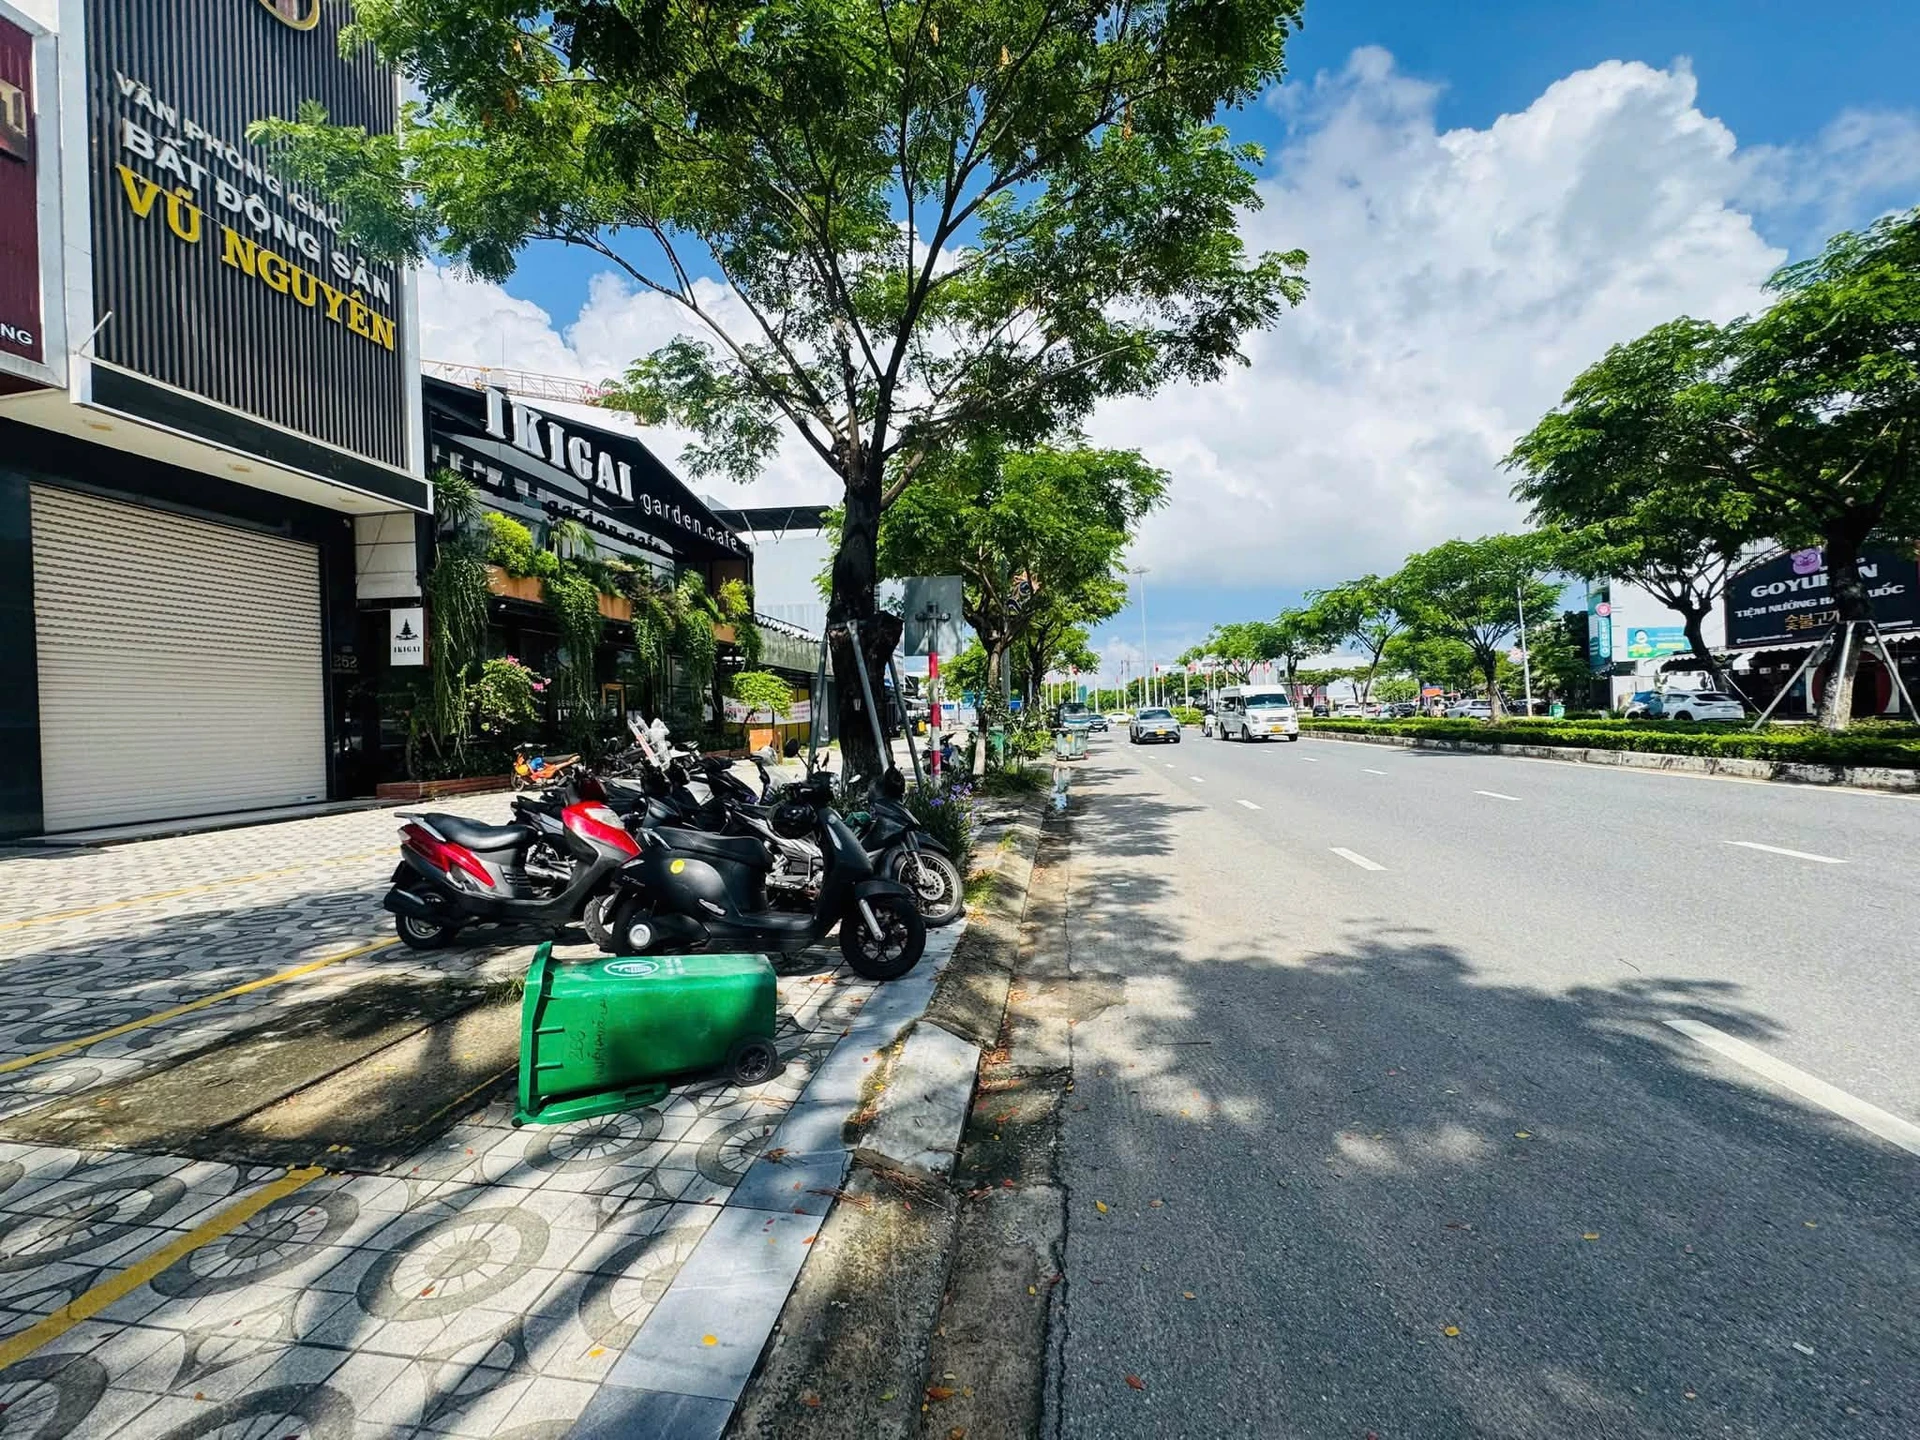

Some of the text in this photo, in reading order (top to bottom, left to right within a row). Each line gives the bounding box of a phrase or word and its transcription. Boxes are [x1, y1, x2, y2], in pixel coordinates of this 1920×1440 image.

[114, 69, 176, 128] VĂN
[184, 118, 282, 197] PHÒNG
[115, 162, 396, 352] VŨ NGUYÊN
[122, 117, 202, 191] BẤT
[215, 177, 321, 263] ĐỘNG
[331, 250, 390, 305] SẢN
[484, 387, 634, 502] IKIGAI
[393, 645, 420, 653] IKIGAI
[1734, 606, 1767, 618] TIỆM
[1867, 582, 1906, 598] UỐC
